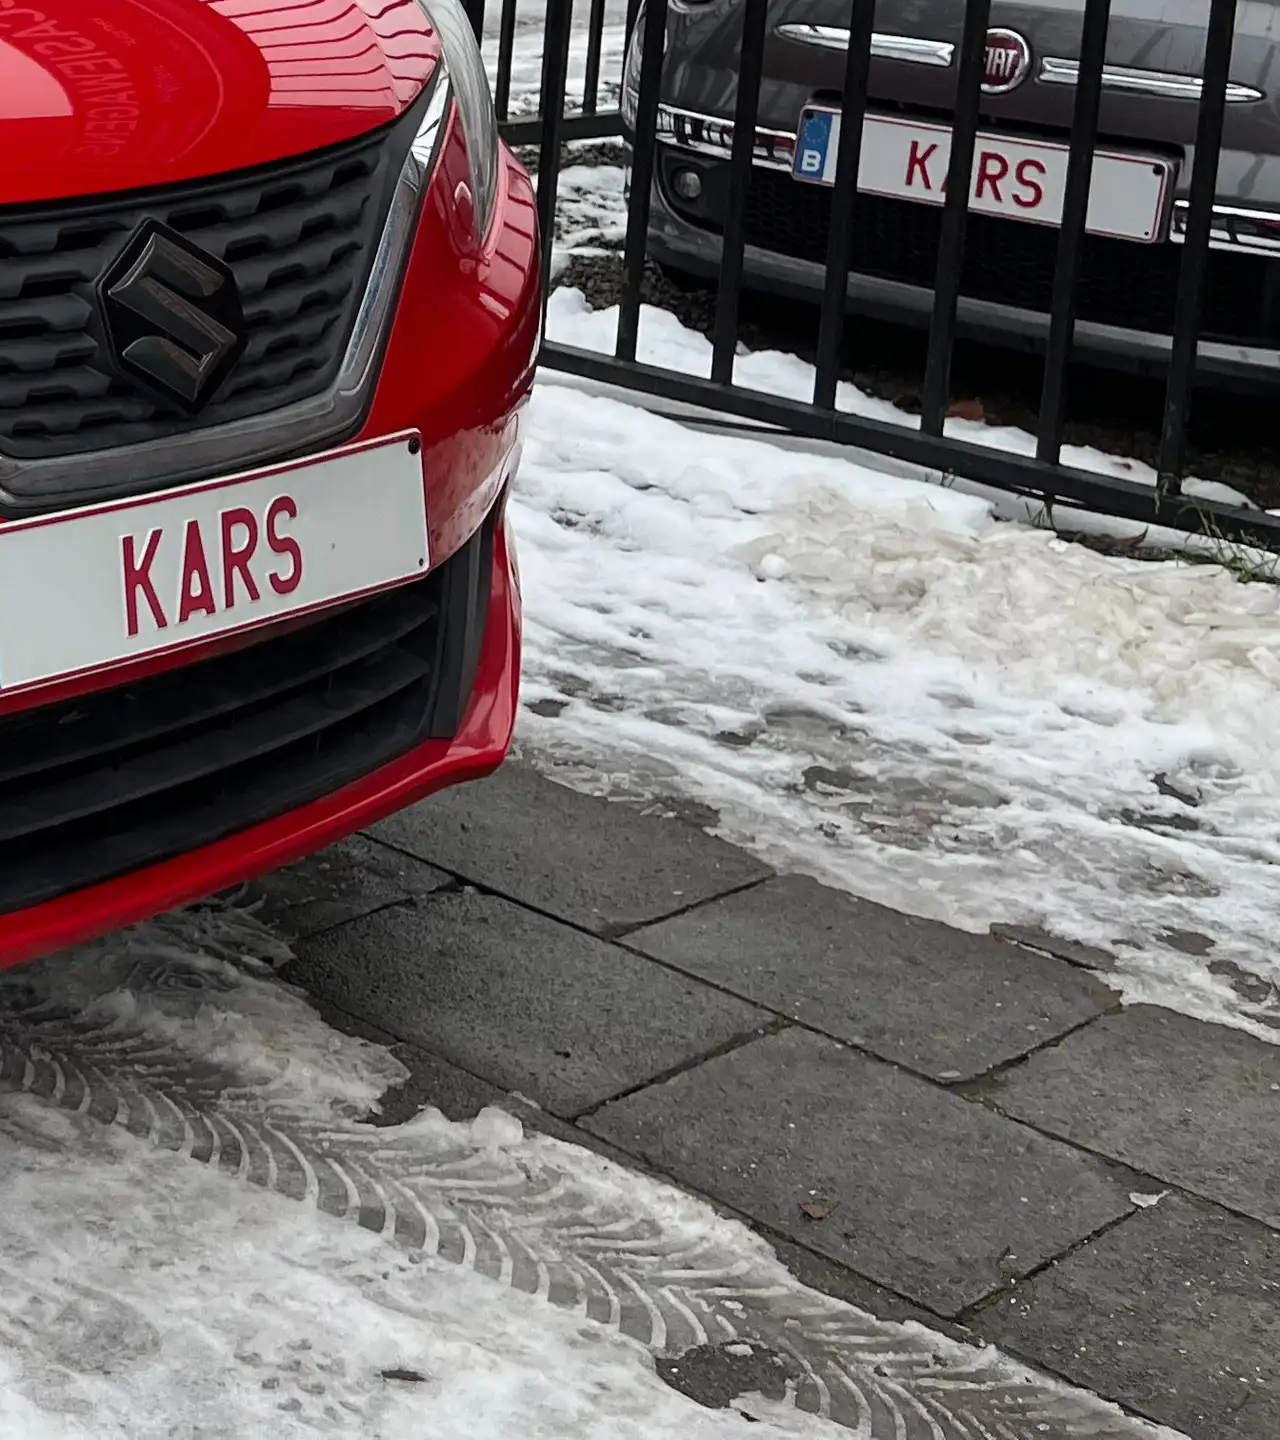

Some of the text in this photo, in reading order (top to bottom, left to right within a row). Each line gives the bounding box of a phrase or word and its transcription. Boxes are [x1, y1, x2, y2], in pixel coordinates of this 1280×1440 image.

[984, 46, 1019, 78] IAT
[800, 139, 1047, 209] B KRS
[121, 494, 304, 639] KARS
